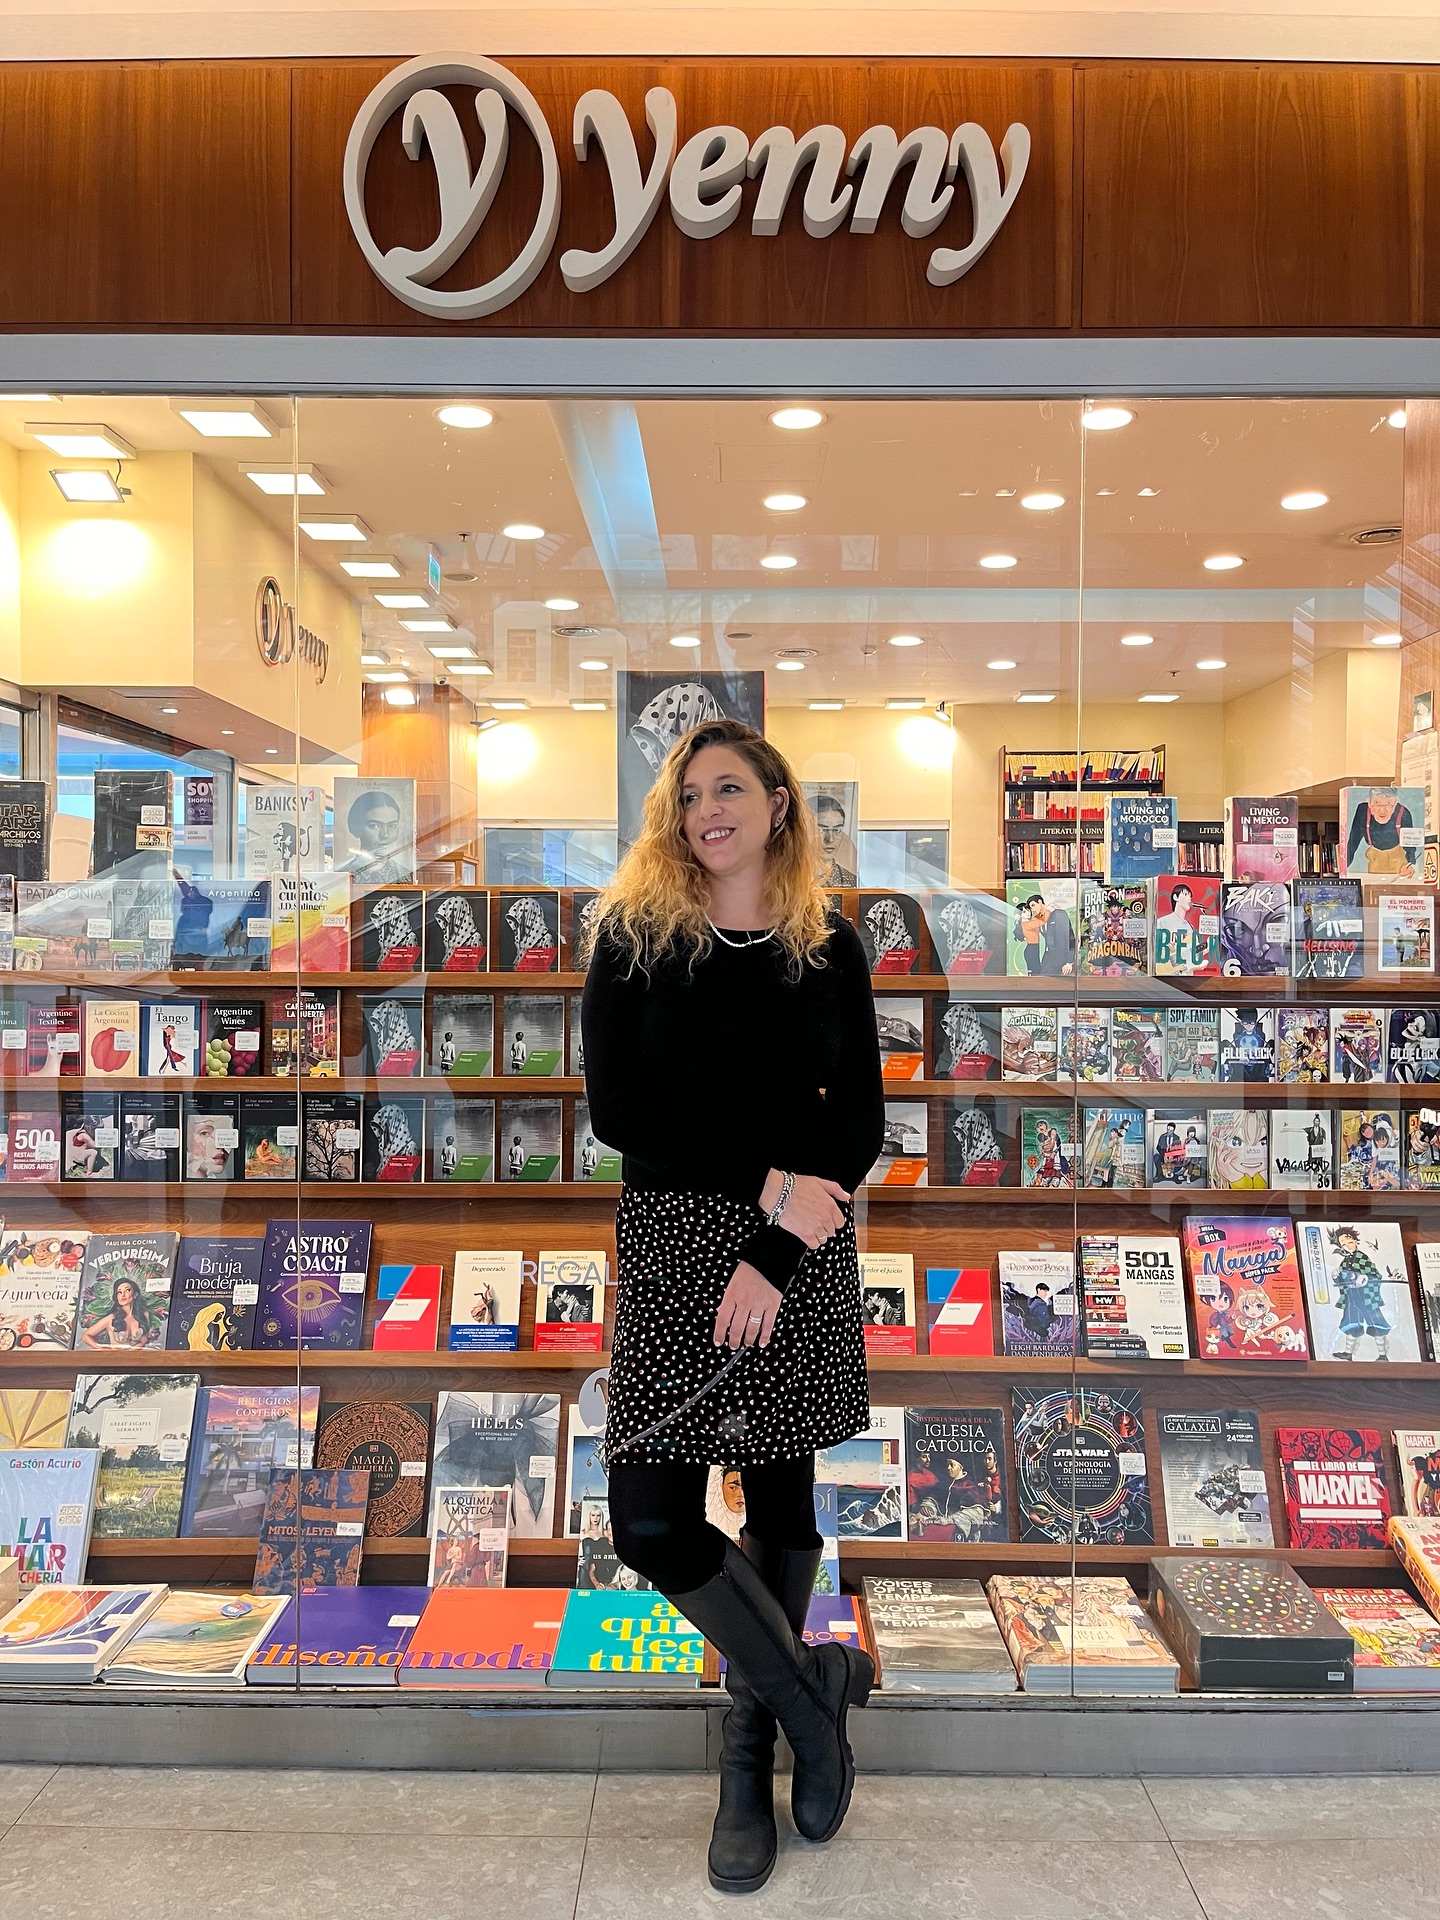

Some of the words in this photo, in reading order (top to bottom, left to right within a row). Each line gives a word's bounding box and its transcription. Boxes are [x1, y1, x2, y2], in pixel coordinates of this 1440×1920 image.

[560, 86, 1031, 292] Yenny
[255, 796, 307, 811] BANKSY
[0, 804, 41, 818] TAR
[1123, 806, 1154, 815] LIVING
[1155, 806, 1166, 815] IN
[1249, 807, 1281, 816] LIVING
[0, 816, 41, 830] ARS
[1120, 815, 1169, 824] MOROCCO
[1241, 816, 1252, 825] IN
[1252, 816, 1290, 825] MEXICO
[279, 879, 318, 891] Nueve
[26, 888, 103, 900] PATAGONIA
[208, 889, 261, 899] Argentina
[278, 890, 330, 902] cuentos
[1224, 958, 1242, 977] 6
[37, 1010, 74, 1018] Argentine
[213, 1008, 254, 1018] Argentine
[155, 1013, 189, 1026] Tango
[221, 1017, 246, 1025] Wines
[1006, 1016, 1056, 1027] ACADEMIA
[1088, 1110, 1144, 1121] Suzume
[15, 1129, 55, 1149] 500
[13, 1163, 36, 1171] BUENOS
[36, 1163, 54, 1171] AIRES
[1317, 1173, 1330, 1188] 36
[1204, 1232, 1220, 1243] BOX
[285, 1236, 349, 1253] ASTRO
[89, 1247, 170, 1269] VERDURÍSIMA
[283, 1256, 348, 1272] COACH
[1124, 1251, 1175, 1268] 501
[1203, 1241, 1287, 1285] Manga
[199, 1257, 243, 1278] Bruja
[520, 1260, 618, 1286] REGAL
[1125, 1269, 1175, 1281] MANGAS
[1, 1289, 69, 1303] Ayurveda
[1033, 1344, 1069, 1352] BARDUGO
[237, 1397, 292, 1406] REFUGIOS
[236, 1408, 291, 1417] COSTEROS
[477, 1404, 521, 1416] CULT
[471, 1417, 524, 1430] HEELS
[1167, 1422, 1218, 1432] GALAXIA
[925, 1423, 986, 1438] IGLESIA
[1226, 1434, 1236, 1442] 24
[1405, 1435, 1436, 1447] MARVEL
[915, 1437, 996, 1454] CATÓLICA
[1052, 1449, 1081, 1457] STAR
[1081, 1449, 1111, 1457] WARS
[9, 1458, 45, 1470] Gastón
[46, 1458, 82, 1470] Acurio
[352, 1455, 394, 1465] MAGIA
[1053, 1460, 1063, 1468] LA
[1311, 1460, 1321, 1471] EL
[1321, 1460, 1345, 1471] LIBRO
[1346, 1460, 1358, 1471] DE
[1297, 1474, 1378, 1505] MARVEL
[443, 1496, 499, 1507] ALQUIMIA
[17, 1517, 53, 1544] LA
[268, 1525, 299, 1535] MITOS
[1, 1544, 68, 1572] MAR
[870, 1580, 934, 1589] VOICES
[873, 1587, 895, 1595] OF
[898, 1587, 933, 1595] THE
[873, 1593, 949, 1602] TEMPEST
[1323, 1593, 1403, 1605] AVENGERS
[876, 1604, 936, 1613] VOCES
[879, 1612, 901, 1620] DE
[903, 1612, 929, 1620] LA
[879, 1619, 984, 1629] TEMPESTAD
[246, 1643, 405, 1667] diseño
[404, 1643, 553, 1670] moda
[588, 1648, 703, 1675] tura
